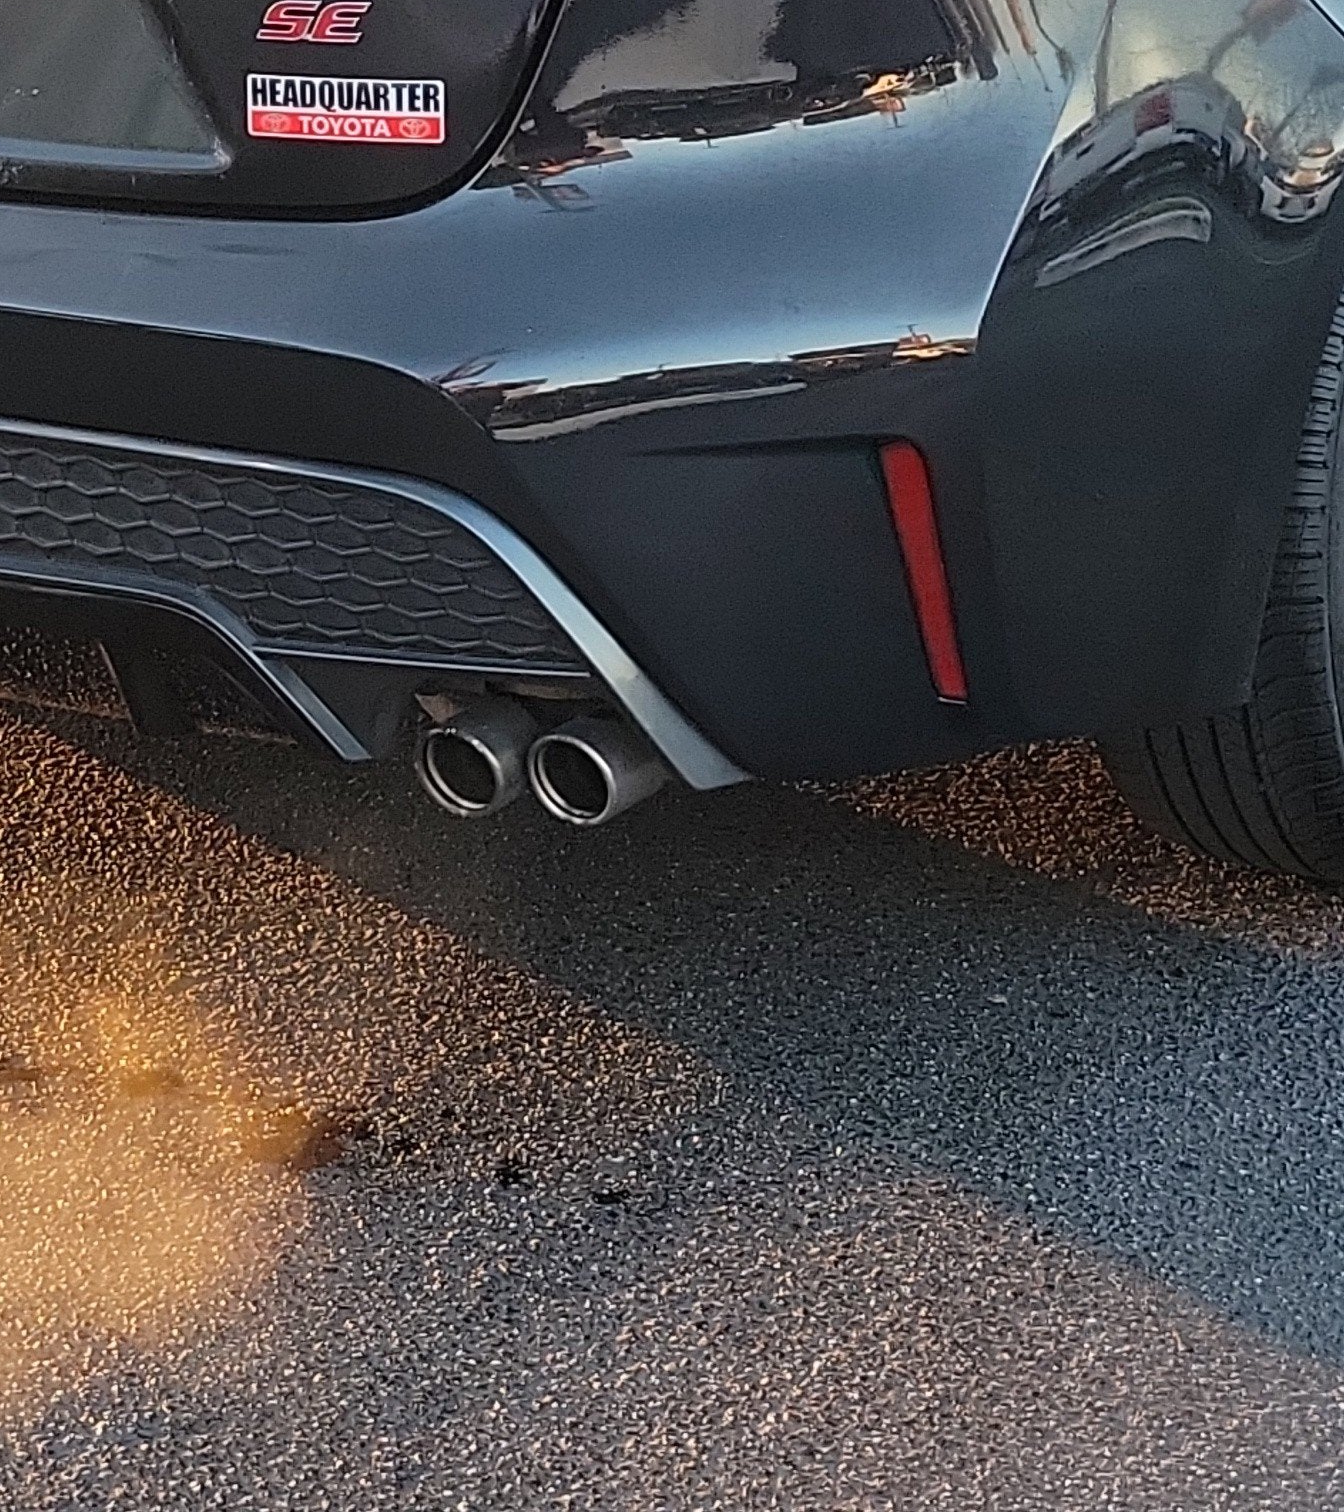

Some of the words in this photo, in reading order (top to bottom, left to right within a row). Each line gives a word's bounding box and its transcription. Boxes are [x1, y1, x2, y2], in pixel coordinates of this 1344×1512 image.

[256, 0, 372, 43] SE
[251, 77, 441, 113] HEADQUARTER
[298, 115, 392, 138] TOYOTA
